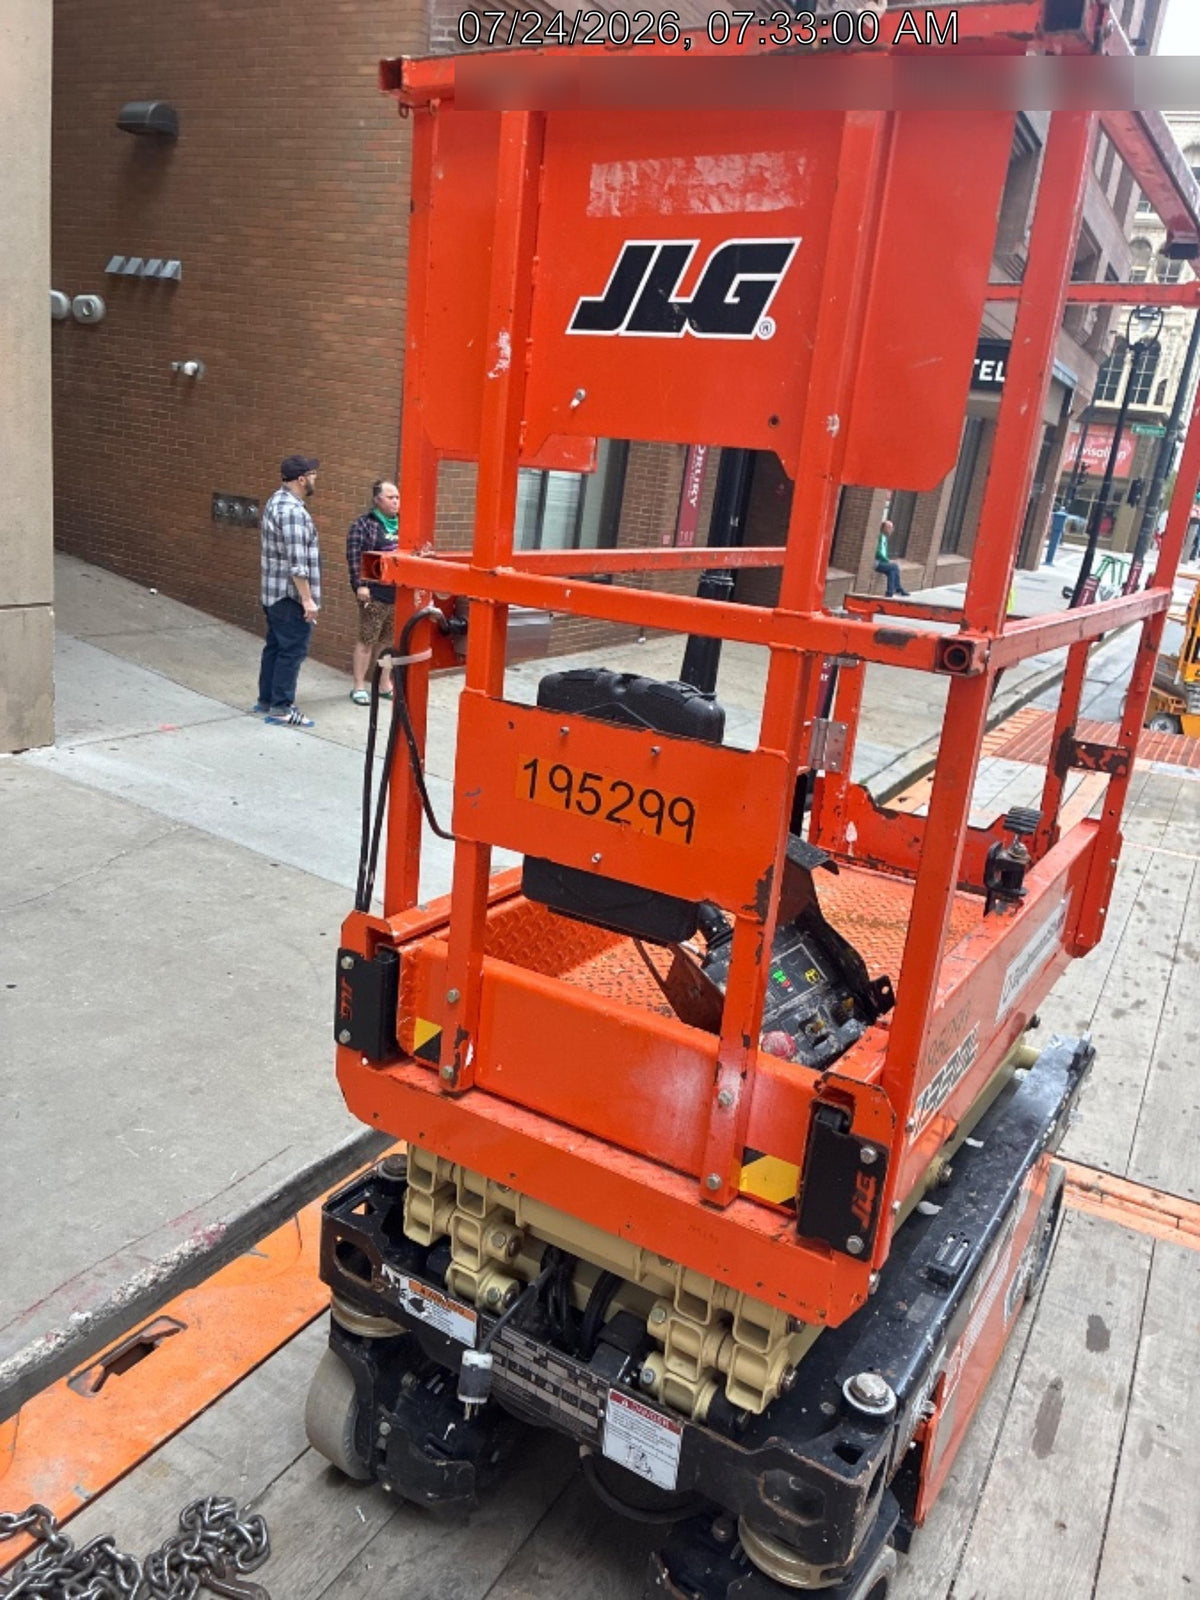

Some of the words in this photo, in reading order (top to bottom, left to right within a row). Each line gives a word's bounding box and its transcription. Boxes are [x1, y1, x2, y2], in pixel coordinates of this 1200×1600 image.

[565, 237, 802, 340] JLG
[973, 358, 1006, 382] EL
[522, 757, 696, 845] 195299
[851, 1169, 877, 1230] JLG
